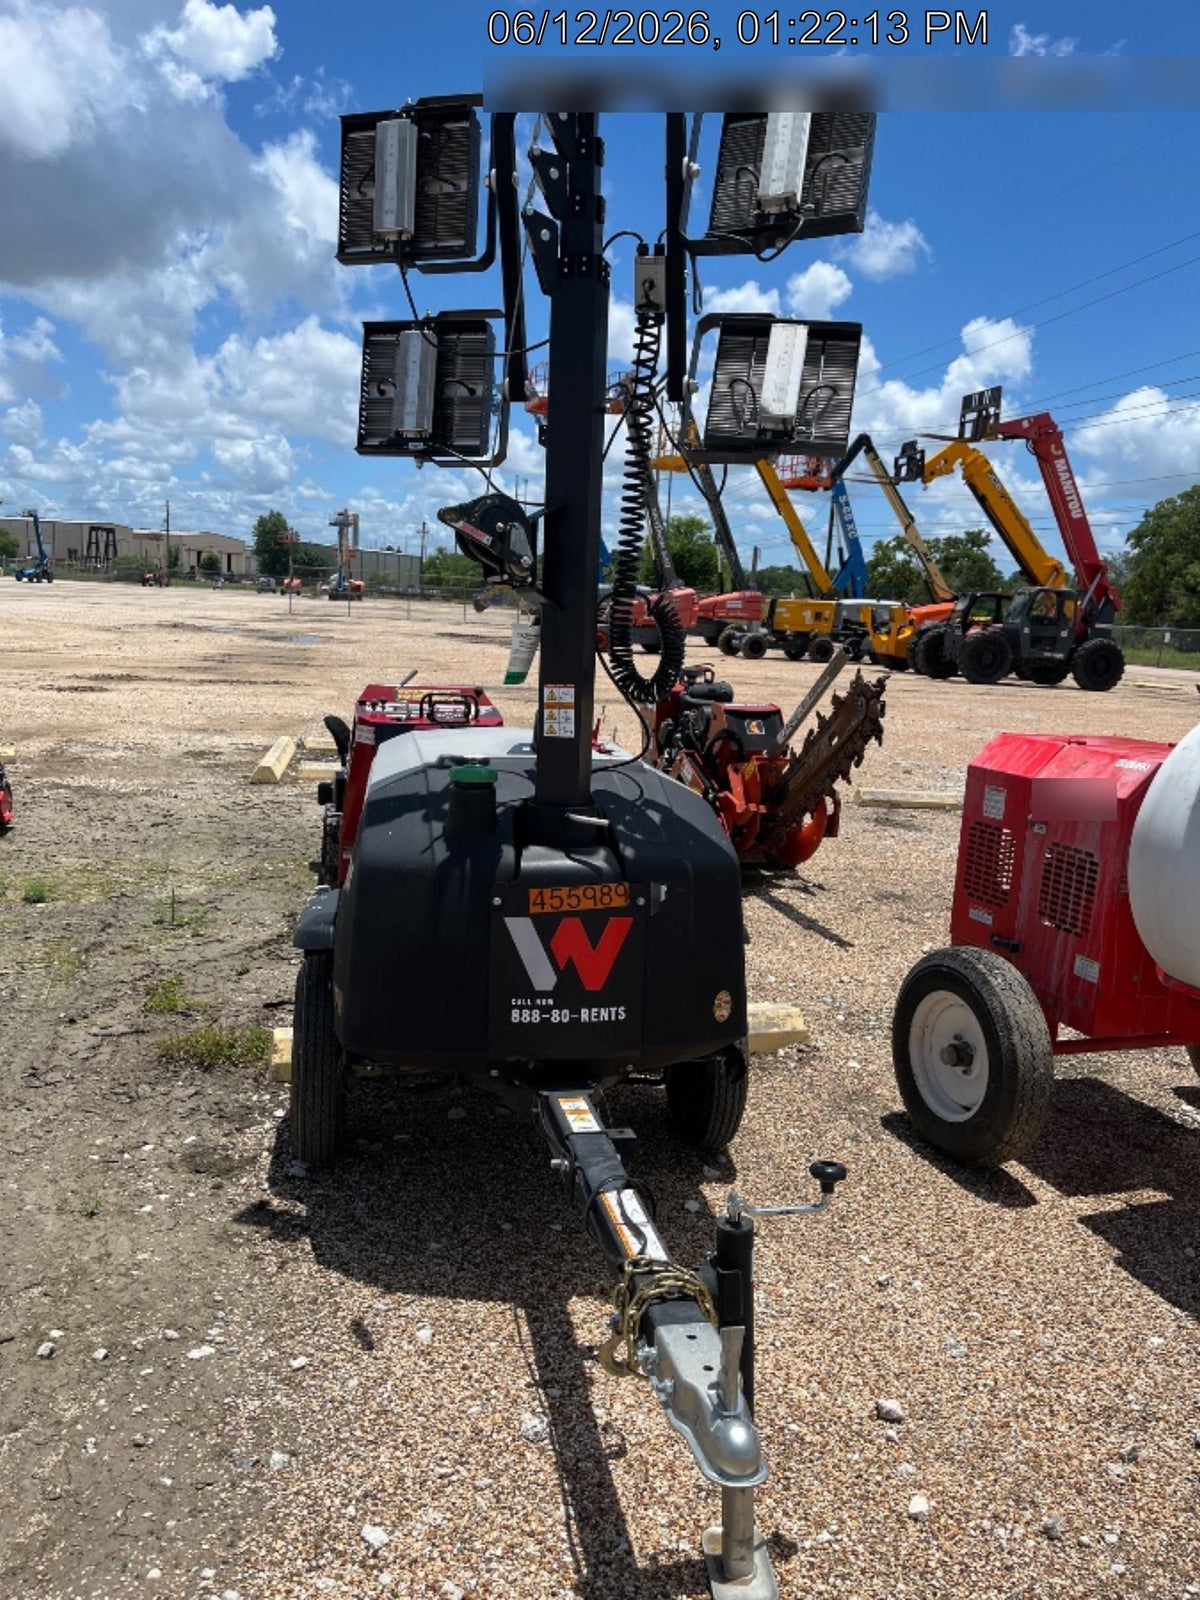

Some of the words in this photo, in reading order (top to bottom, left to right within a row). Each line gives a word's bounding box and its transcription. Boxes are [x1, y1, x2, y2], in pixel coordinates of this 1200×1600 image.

[1054, 458, 1083, 519] MANITOU
[531, 882, 628, 911] 455989
[511, 998, 532, 1006] CALL
[511, 1005, 627, 1023] 888-80-RENTS
